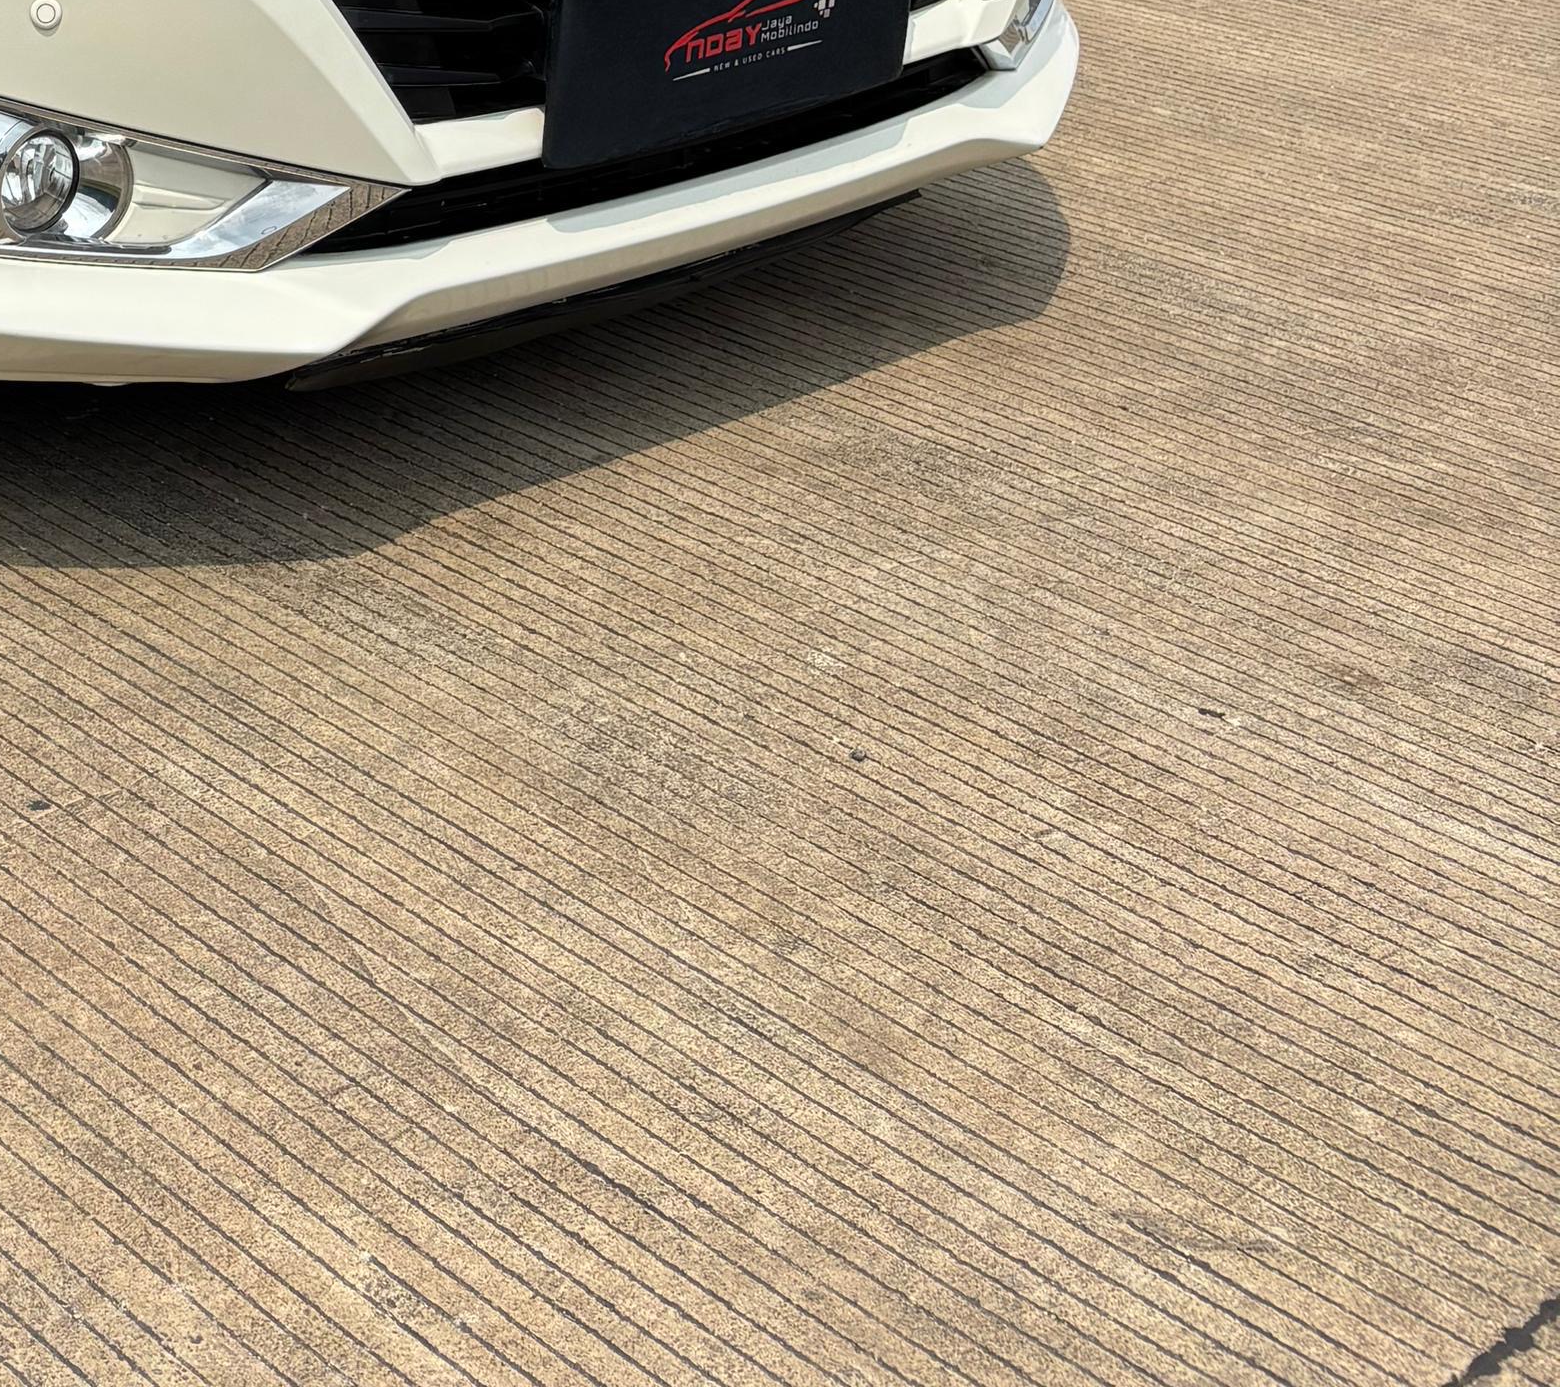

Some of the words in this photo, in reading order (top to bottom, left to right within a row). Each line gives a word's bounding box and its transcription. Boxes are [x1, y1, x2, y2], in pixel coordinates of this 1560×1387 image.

[761, 15, 793, 31] Jaya
[761, 20, 819, 43] Mobilindo
[742, 52, 763, 65] USED
[765, 47, 786, 59] CARS
